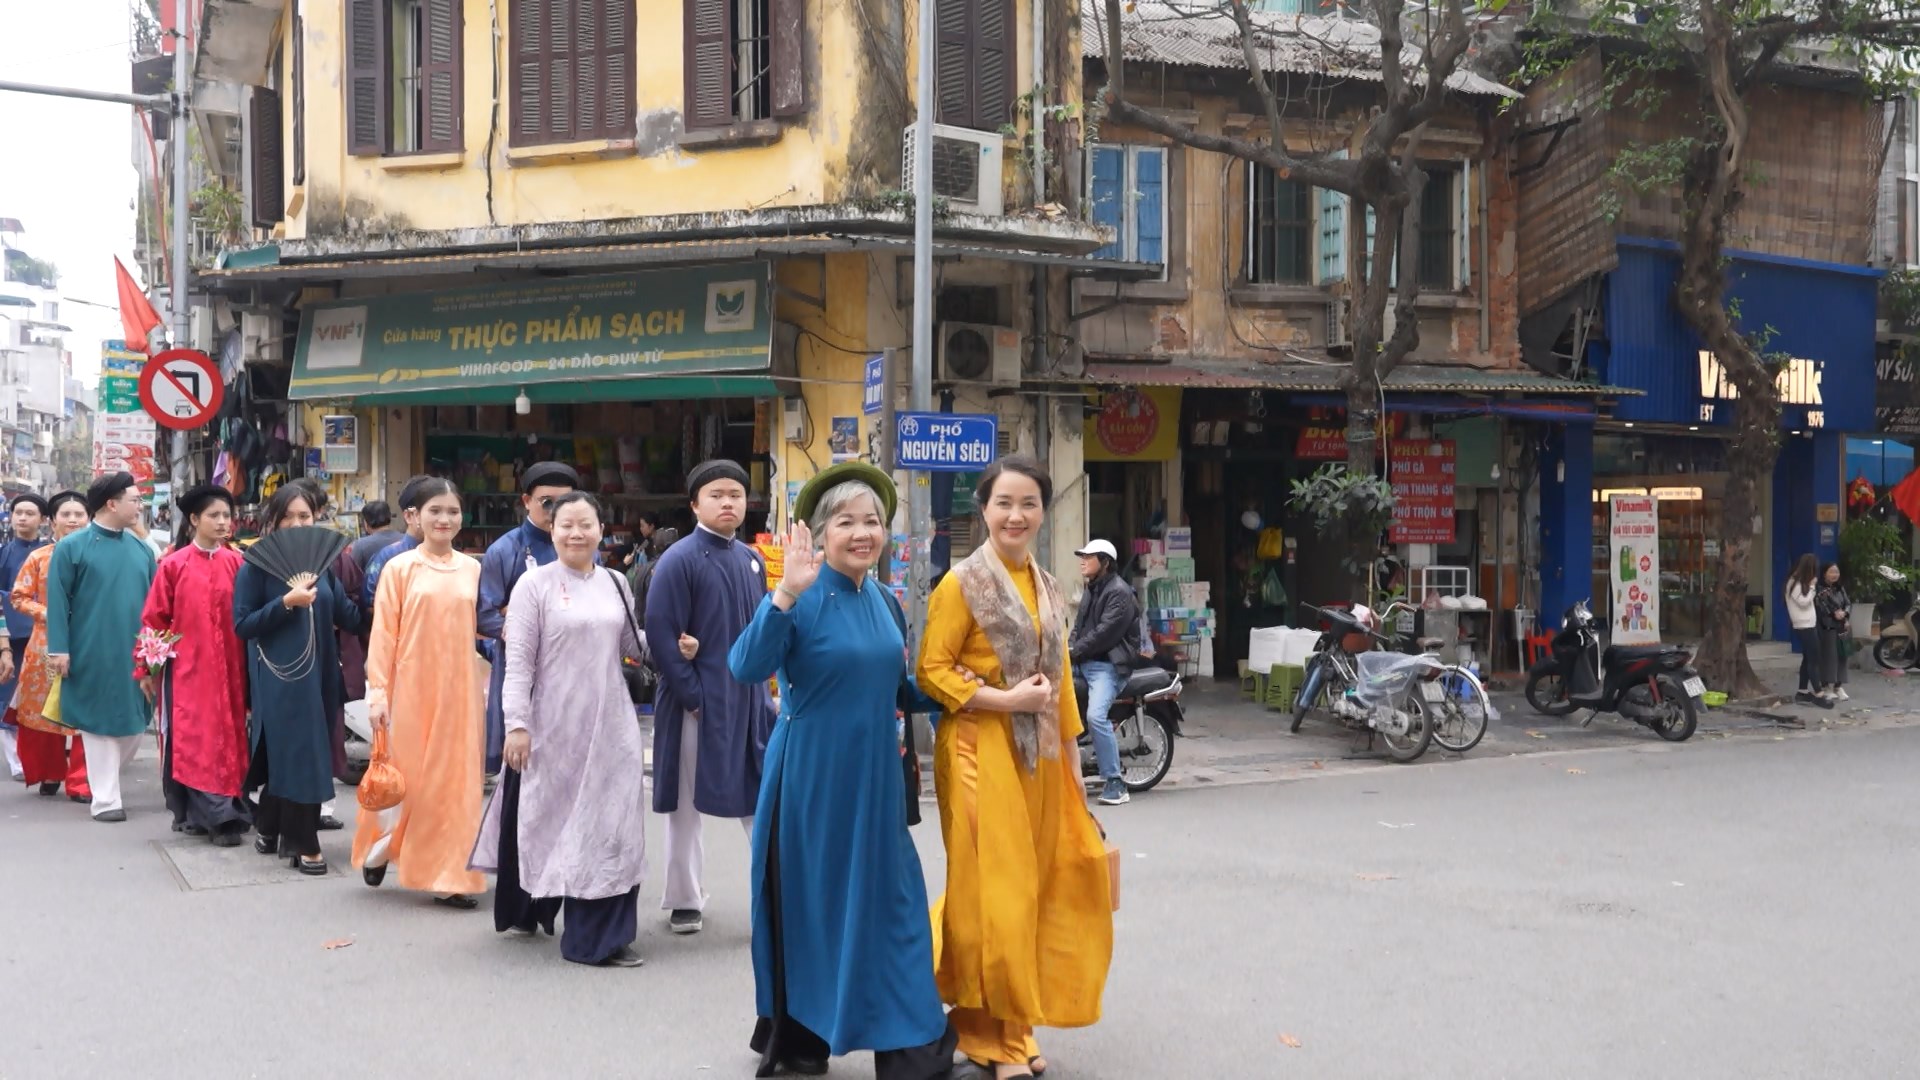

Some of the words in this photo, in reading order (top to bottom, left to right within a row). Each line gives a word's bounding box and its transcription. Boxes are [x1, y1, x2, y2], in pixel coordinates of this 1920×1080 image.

[411, 328, 442, 343] hàng
[448, 319, 518, 354] THỰC
[525, 305, 602, 344] PHẨM
[610, 309, 685, 344] SẠCH
[609, 351, 639, 366] DUY
[643, 347, 664, 364] TỪ
[1700, 404, 1714, 422] EST
[930, 421, 962, 436] PHỐ
[902, 434, 956, 462] NGUYỄN
[960, 439, 990, 462] SIÊU
[1616, 499, 1653, 512] Vinamilk
